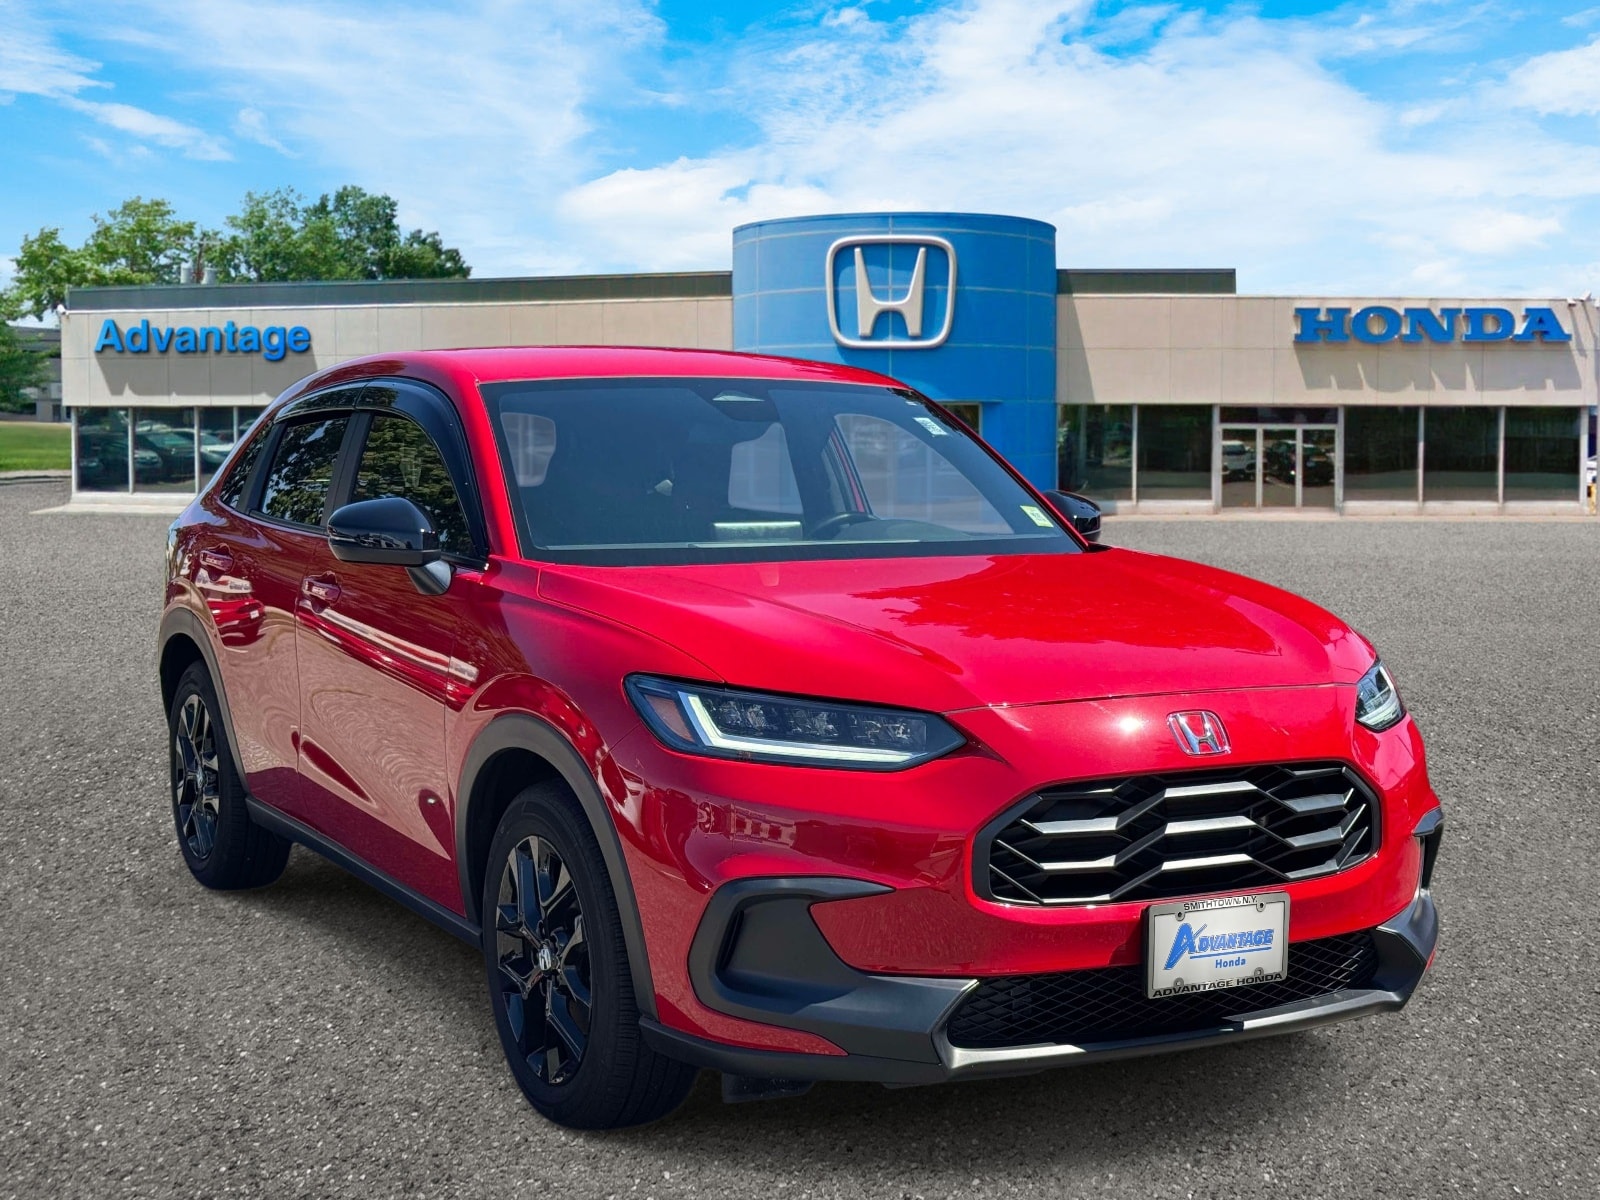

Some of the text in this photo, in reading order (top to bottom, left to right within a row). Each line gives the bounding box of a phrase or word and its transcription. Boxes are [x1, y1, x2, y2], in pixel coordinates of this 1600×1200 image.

[95, 319, 311, 361] Advantage
[1293, 306, 1572, 343] HONDA
[1164, 923, 1275, 970] ADVANTAGE
[1215, 957, 1246, 969] Honda
[1152, 973, 1283, 998] ADVANTAGE HONDA
